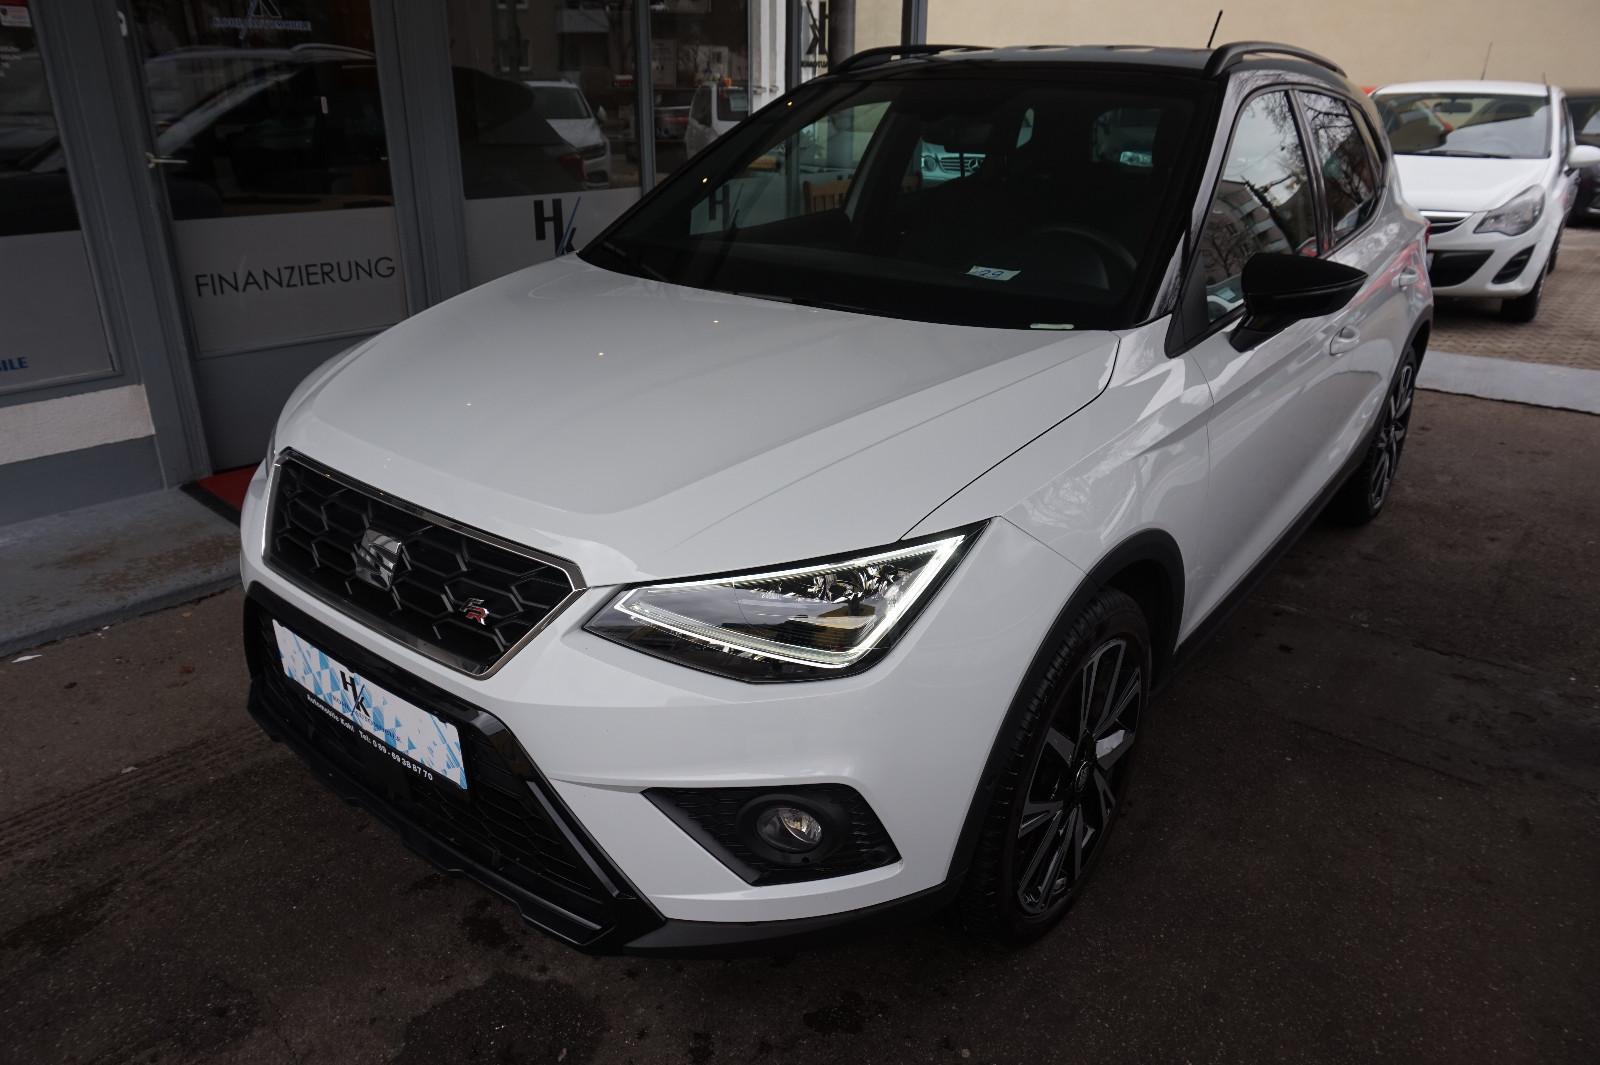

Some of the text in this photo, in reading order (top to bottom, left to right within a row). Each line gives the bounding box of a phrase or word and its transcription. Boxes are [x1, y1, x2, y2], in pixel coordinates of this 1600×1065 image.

[194, 256, 396, 297] FINANZIERUNG
[0, 356, 29, 372] ILE
[422, 769, 433, 781] 70
